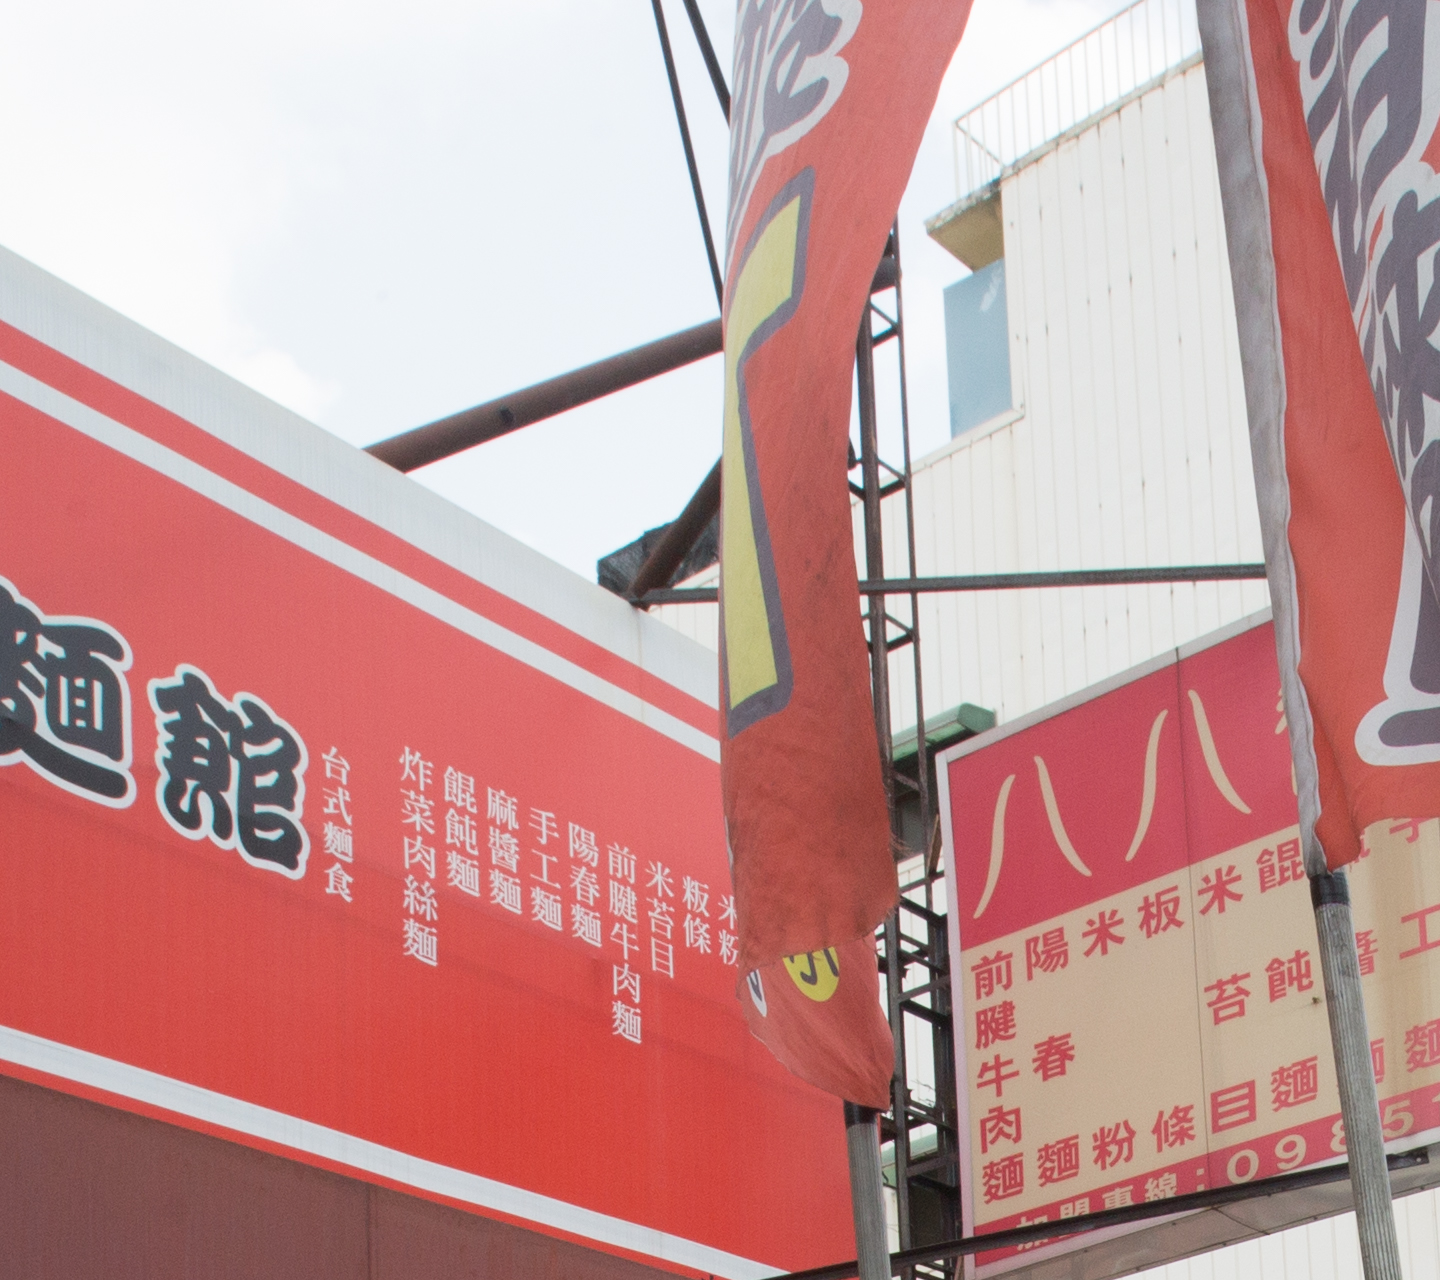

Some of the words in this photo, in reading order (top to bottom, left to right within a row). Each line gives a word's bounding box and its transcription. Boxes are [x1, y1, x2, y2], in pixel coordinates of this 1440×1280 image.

[321, 746, 354, 903] 台式麵食
[398, 746, 439, 967] 炸菜肉絲麵
[443, 765, 481, 898] 餛飩麵
[486, 786, 523, 915] 麻醬麵
[529, 806, 563, 932] 手工麵
[568, 821, 603, 948] 陽春麵
[607, 842, 642, 1045] 前腱牛肉麵
[645, 860, 675, 979] 米苔目
[682, 875, 712, 955] 粄條
[1026, 923, 1080, 1190] 陽春麵
[1197, 865, 1259, 1134] 米苔目
[971, 953, 1026, 1206] 前腱牛肉麵
